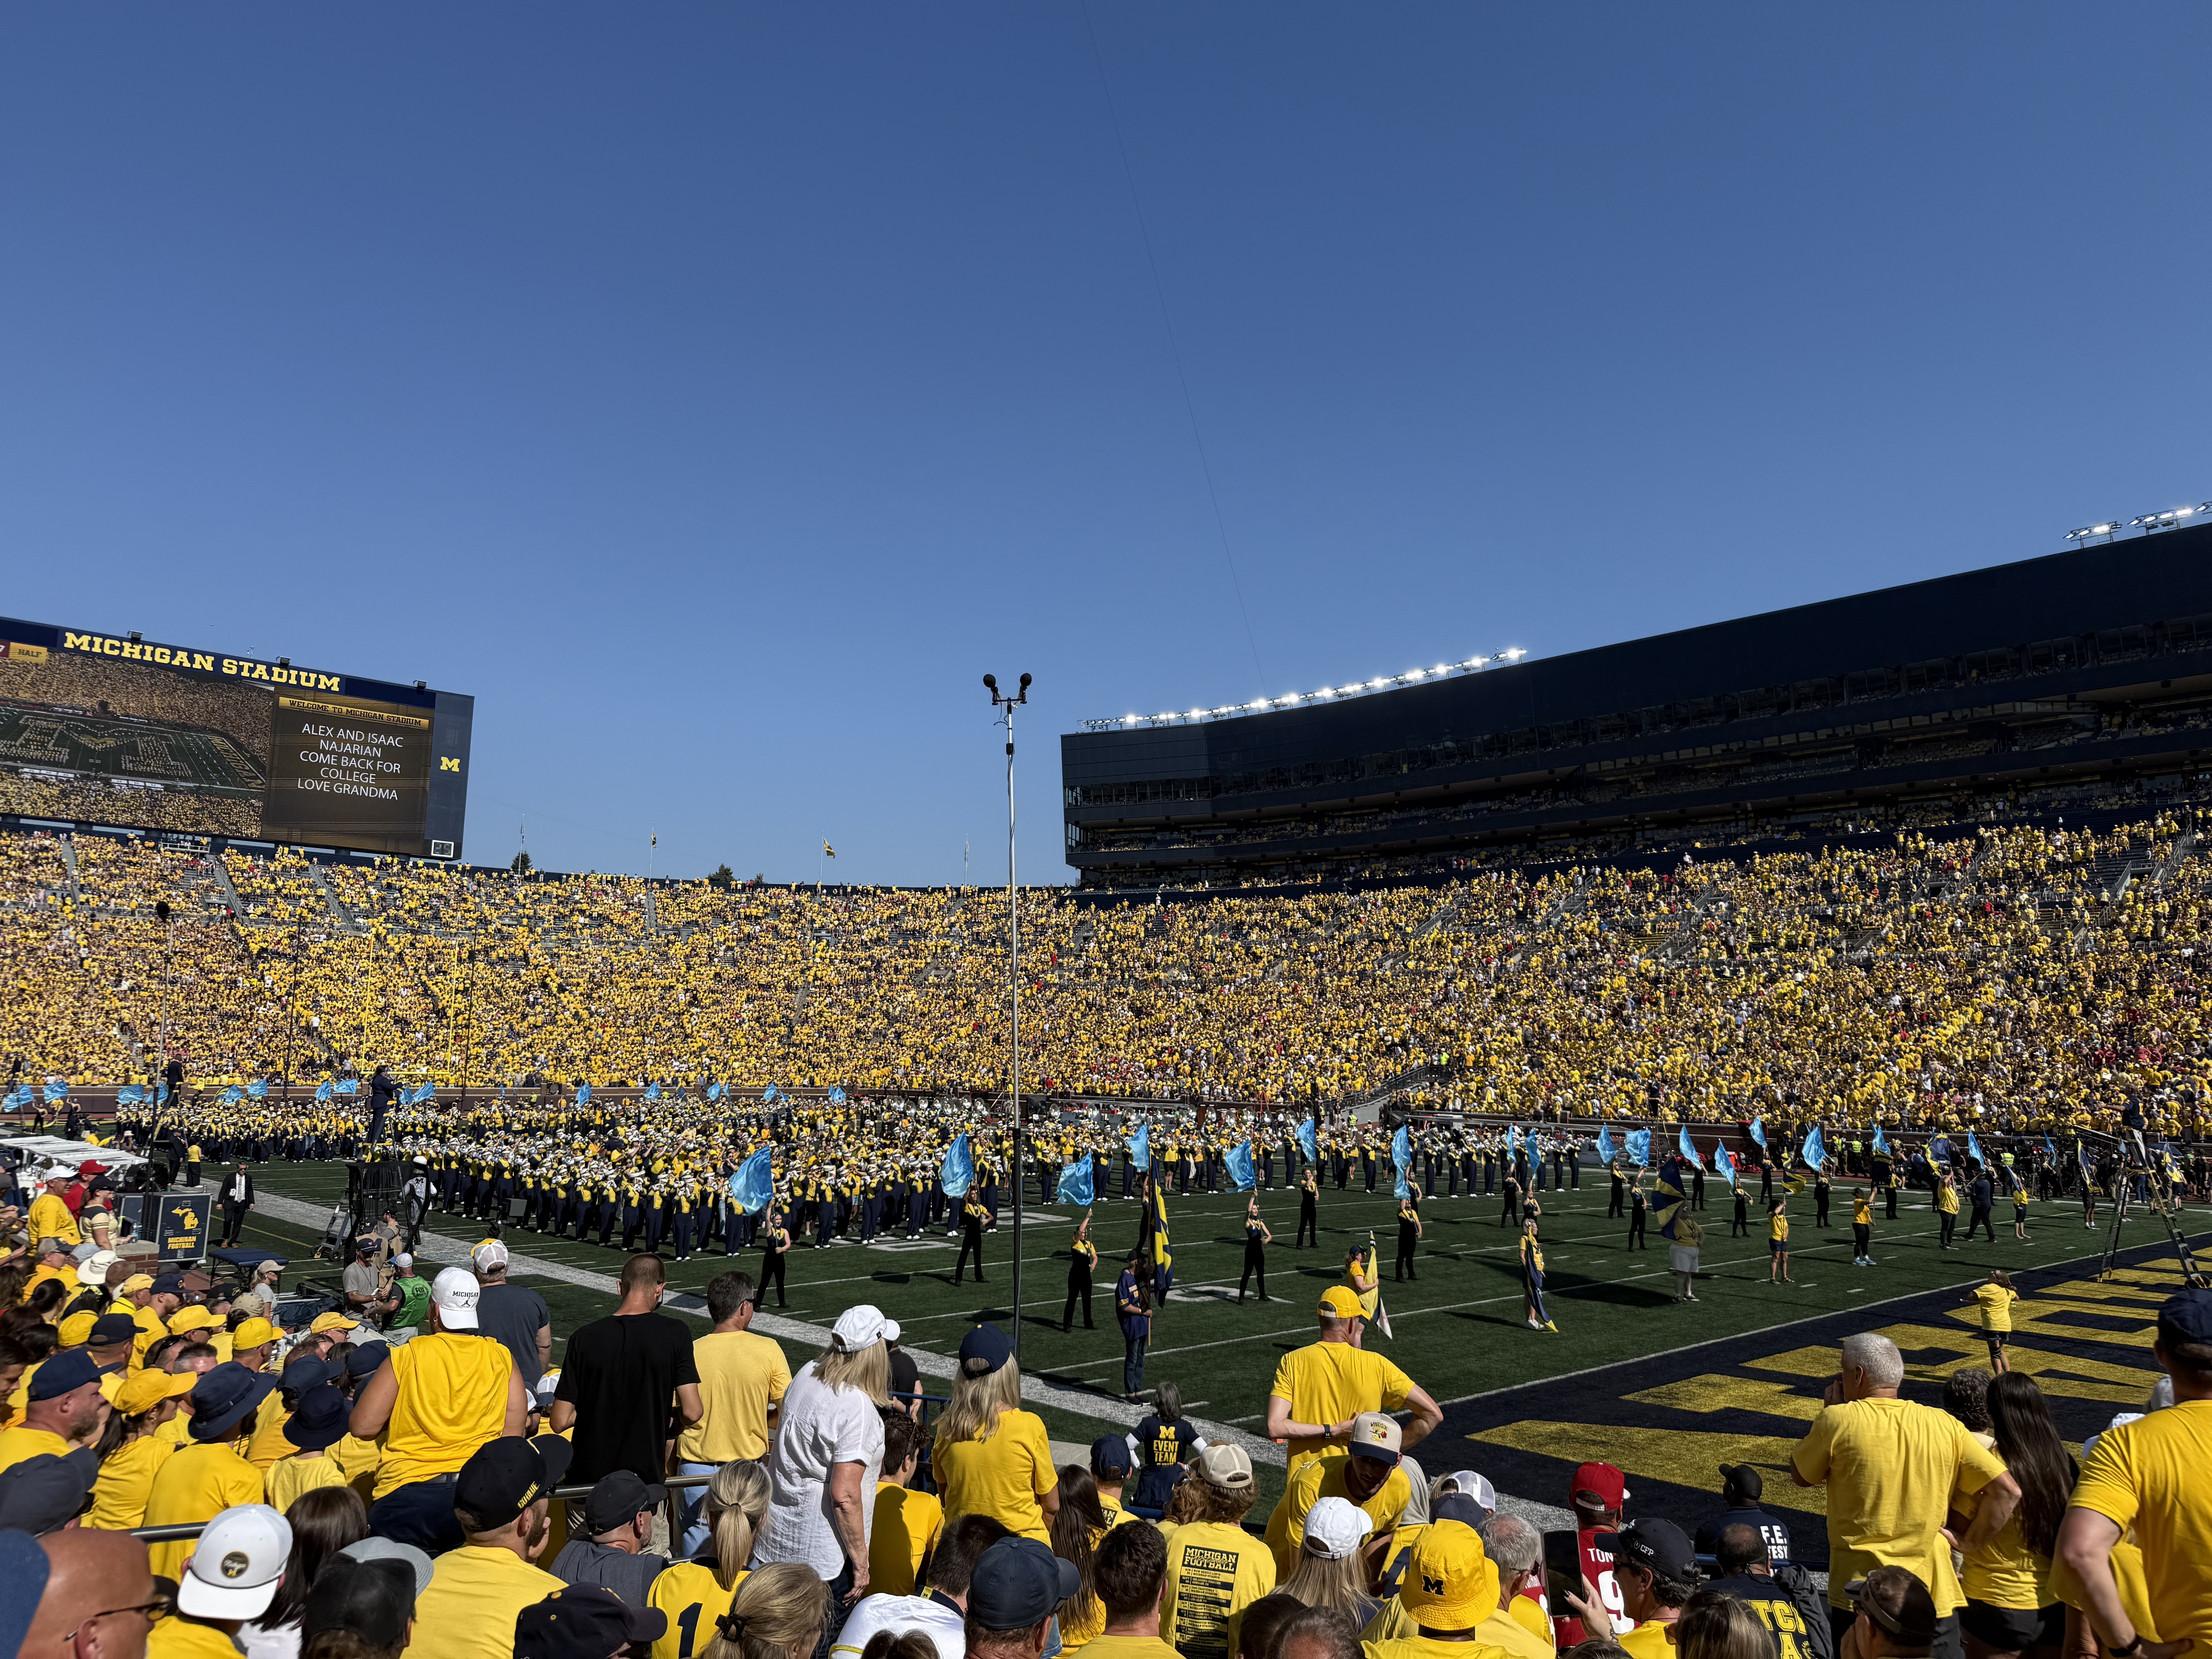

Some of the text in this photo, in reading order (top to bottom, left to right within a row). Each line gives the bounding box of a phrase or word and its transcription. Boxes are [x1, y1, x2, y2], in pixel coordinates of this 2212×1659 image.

[18, 649, 41, 657] HALF
[64, 632, 340, 691] MICHIGAN STADIUM
[289, 700, 329, 712] WELCOME
[346, 709, 383, 720] MICHIGAN
[386, 715, 421, 726] STADIUM
[302, 723, 403, 747] ALEX AND ISAAC
[320, 740, 381, 757] NAJARIAN
[300, 751, 400, 774] COME BACK FOR
[440, 756, 460, 772] M
[320, 768, 376, 784] COLLEGE
[298, 778, 398, 800] LOVE GRANDMA
[434, 844, 452, 855] 25
[415, 1286, 426, 1295] FOX
[1159, 1425, 1175, 1440] M
[1154, 1440, 1179, 1452] EVENT
[1154, 1451, 1177, 1463] TEAM
[1185, 1547, 1237, 1564] MICHIGAN
[1587, 1548, 1614, 1563] TON
[1640, 1544, 1654, 1556] CFP
[1767, 1546, 1788, 1559] TESY
[1184, 1556, 1235, 1571] FOOTBALL
[1422, 1573, 1445, 1596] M
[1598, 1571, 1635, 1634] 9
[677, 1602, 703, 1659] 1
